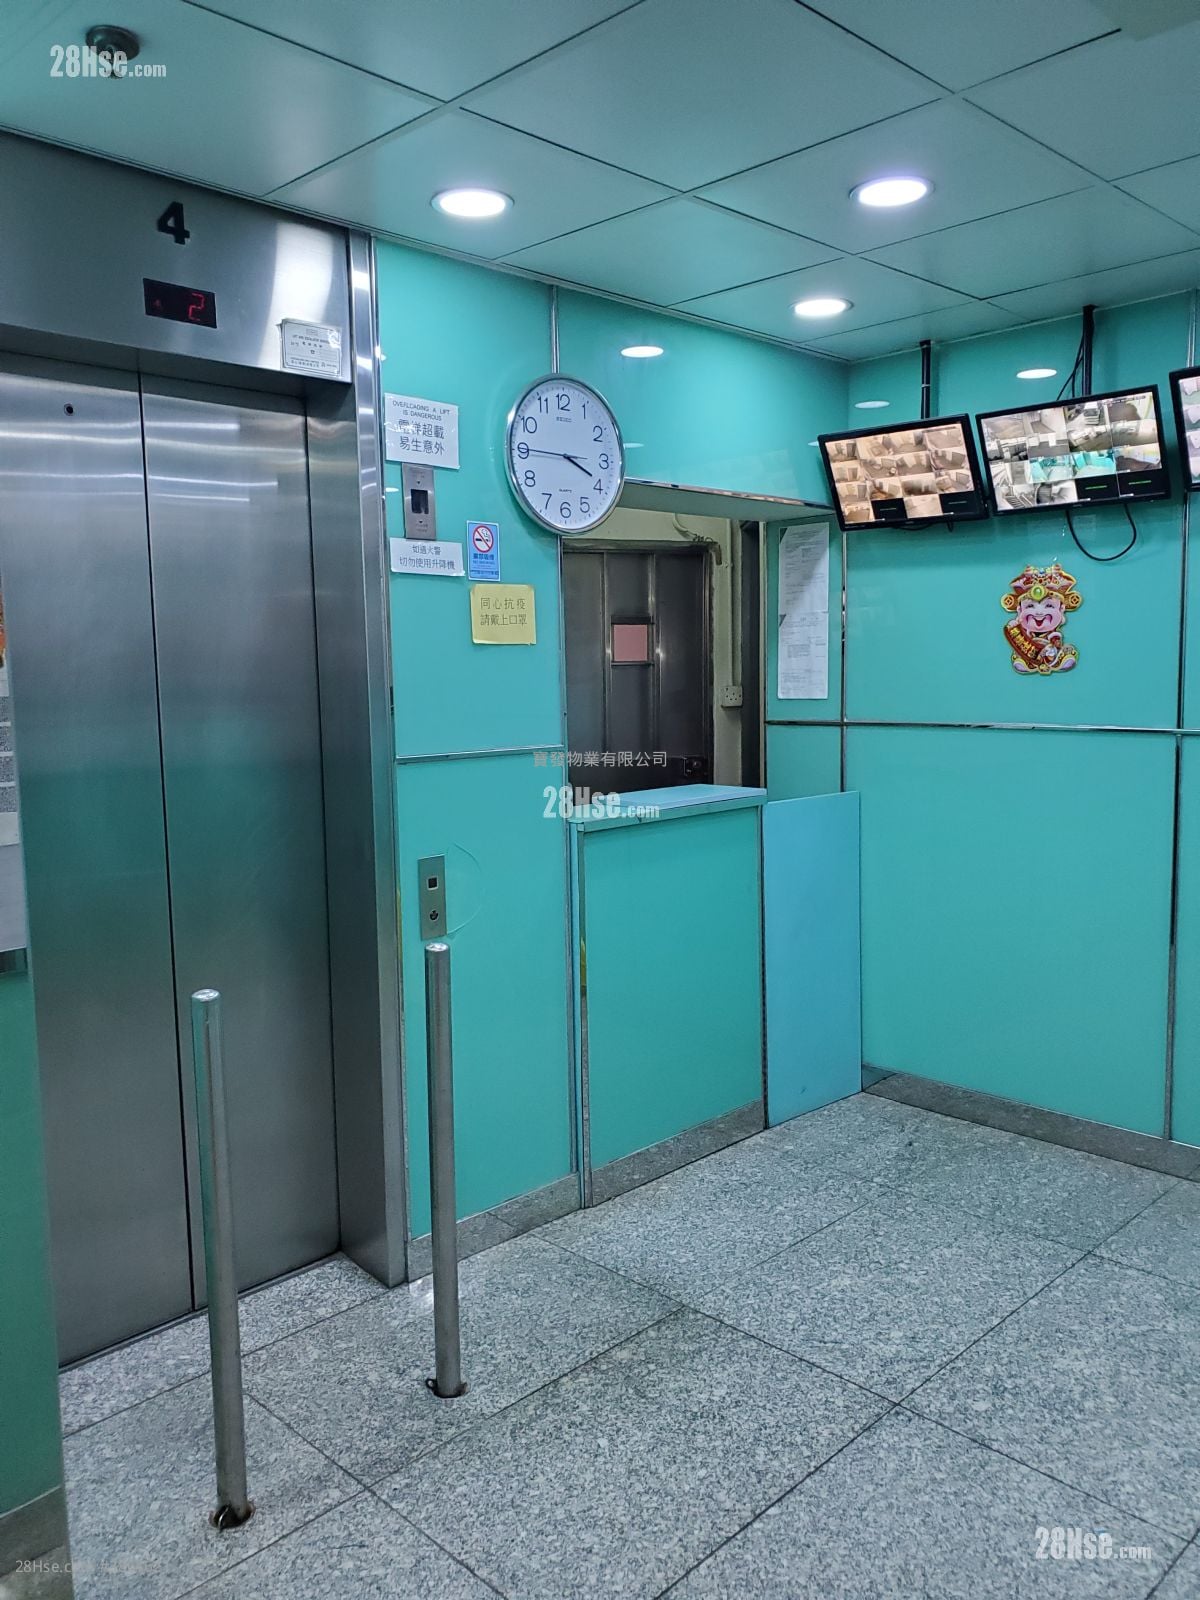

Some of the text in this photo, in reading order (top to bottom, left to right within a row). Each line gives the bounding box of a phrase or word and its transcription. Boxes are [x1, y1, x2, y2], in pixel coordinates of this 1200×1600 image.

[157, 201, 190, 245] 4
[188, 292, 205, 321] 2
[392, 400, 430, 412] OVERLOADING
[537, 396, 549, 414] 11
[555, 393, 571, 411] 12
[410, 410, 442, 421] DANGEROUS
[582, 403, 586, 420] 1
[520, 415, 537, 434] 10
[592, 425, 603, 443] 2
[399, 436, 446, 456] 易生意外
[517, 442, 529, 459] 9
[599, 453, 609, 470] 3
[524, 469, 536, 488] 8
[593, 479, 603, 495] 4
[541, 492, 552, 510] 7
[560, 501, 571, 519] 6
[579, 496, 590, 514] 5
[412, 544, 442, 556] 如遇火警
[399, 556, 456, 570] 切勿使用升降機
[480, 597, 526, 610] 同心抗疫
[480, 613, 528, 627] 請戴上口罩
